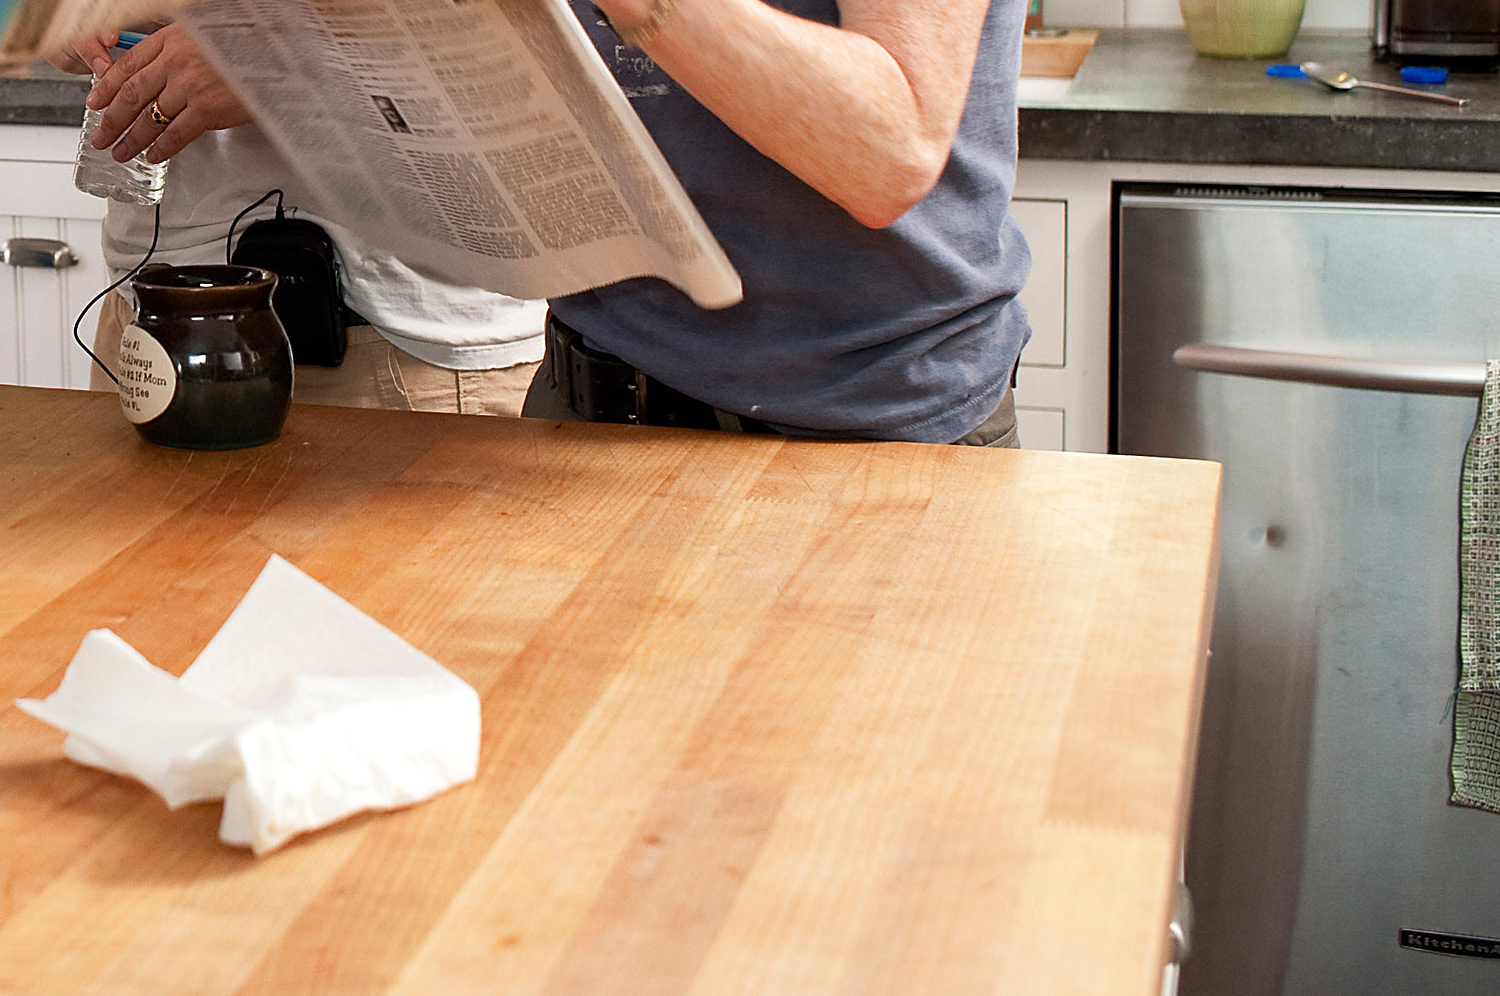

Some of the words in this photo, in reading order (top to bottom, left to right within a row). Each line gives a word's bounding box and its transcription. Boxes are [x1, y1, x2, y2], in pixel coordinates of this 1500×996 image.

[126, 353, 153, 370] Always
[127, 370, 134, 380] #2
[135, 371, 142, 382] If
[143, 372, 167, 386] Mom
[135, 387, 150, 398] See
